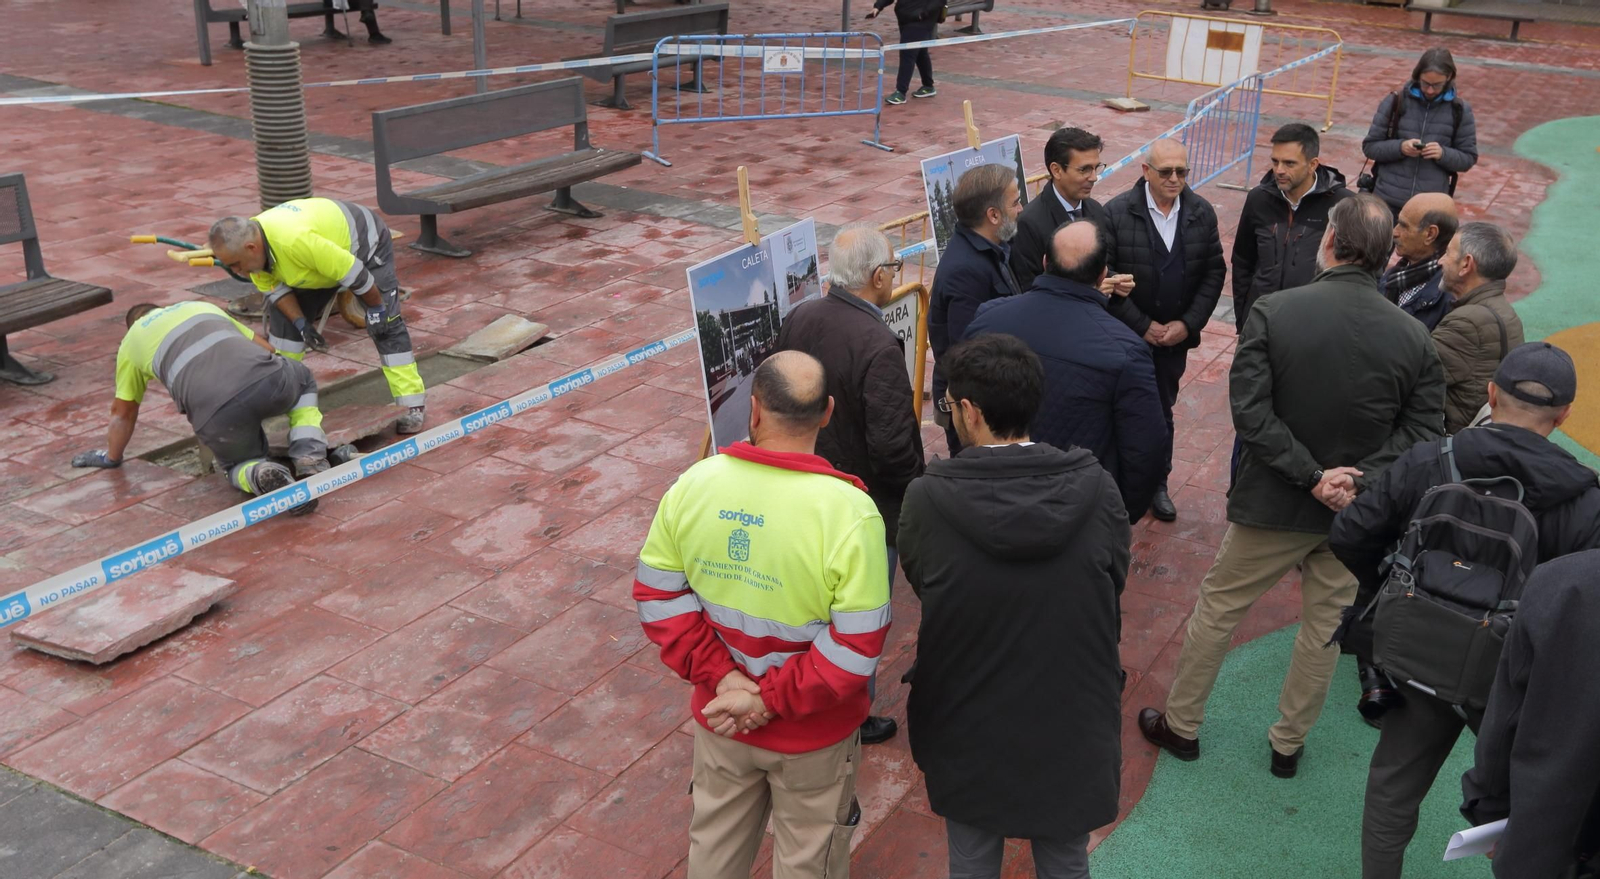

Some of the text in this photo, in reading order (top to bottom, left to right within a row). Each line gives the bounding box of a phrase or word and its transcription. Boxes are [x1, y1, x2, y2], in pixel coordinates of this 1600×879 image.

[964, 155, 986, 168] CALETA
[741, 250, 769, 269] CALETA
[40, 592, 58, 606] NO
[61, 576, 98, 598] PASAR
[191, 532, 207, 546] NO
[208, 519, 239, 539] PASAR
[316, 482, 331, 494] NO
[331, 471, 358, 489] PASAR
[423, 439, 435, 450] NO
[436, 430, 460, 445] PASAR
[516, 401, 528, 411] NO
[528, 393, 548, 407] PASAR
[597, 368, 607, 377] NO
[608, 361, 626, 374] PASAR
[700, 568, 774, 592] SERVICIO DE JARDINES
[744, 566, 752, 575] DE
[752, 569, 783, 588] GRANADA
